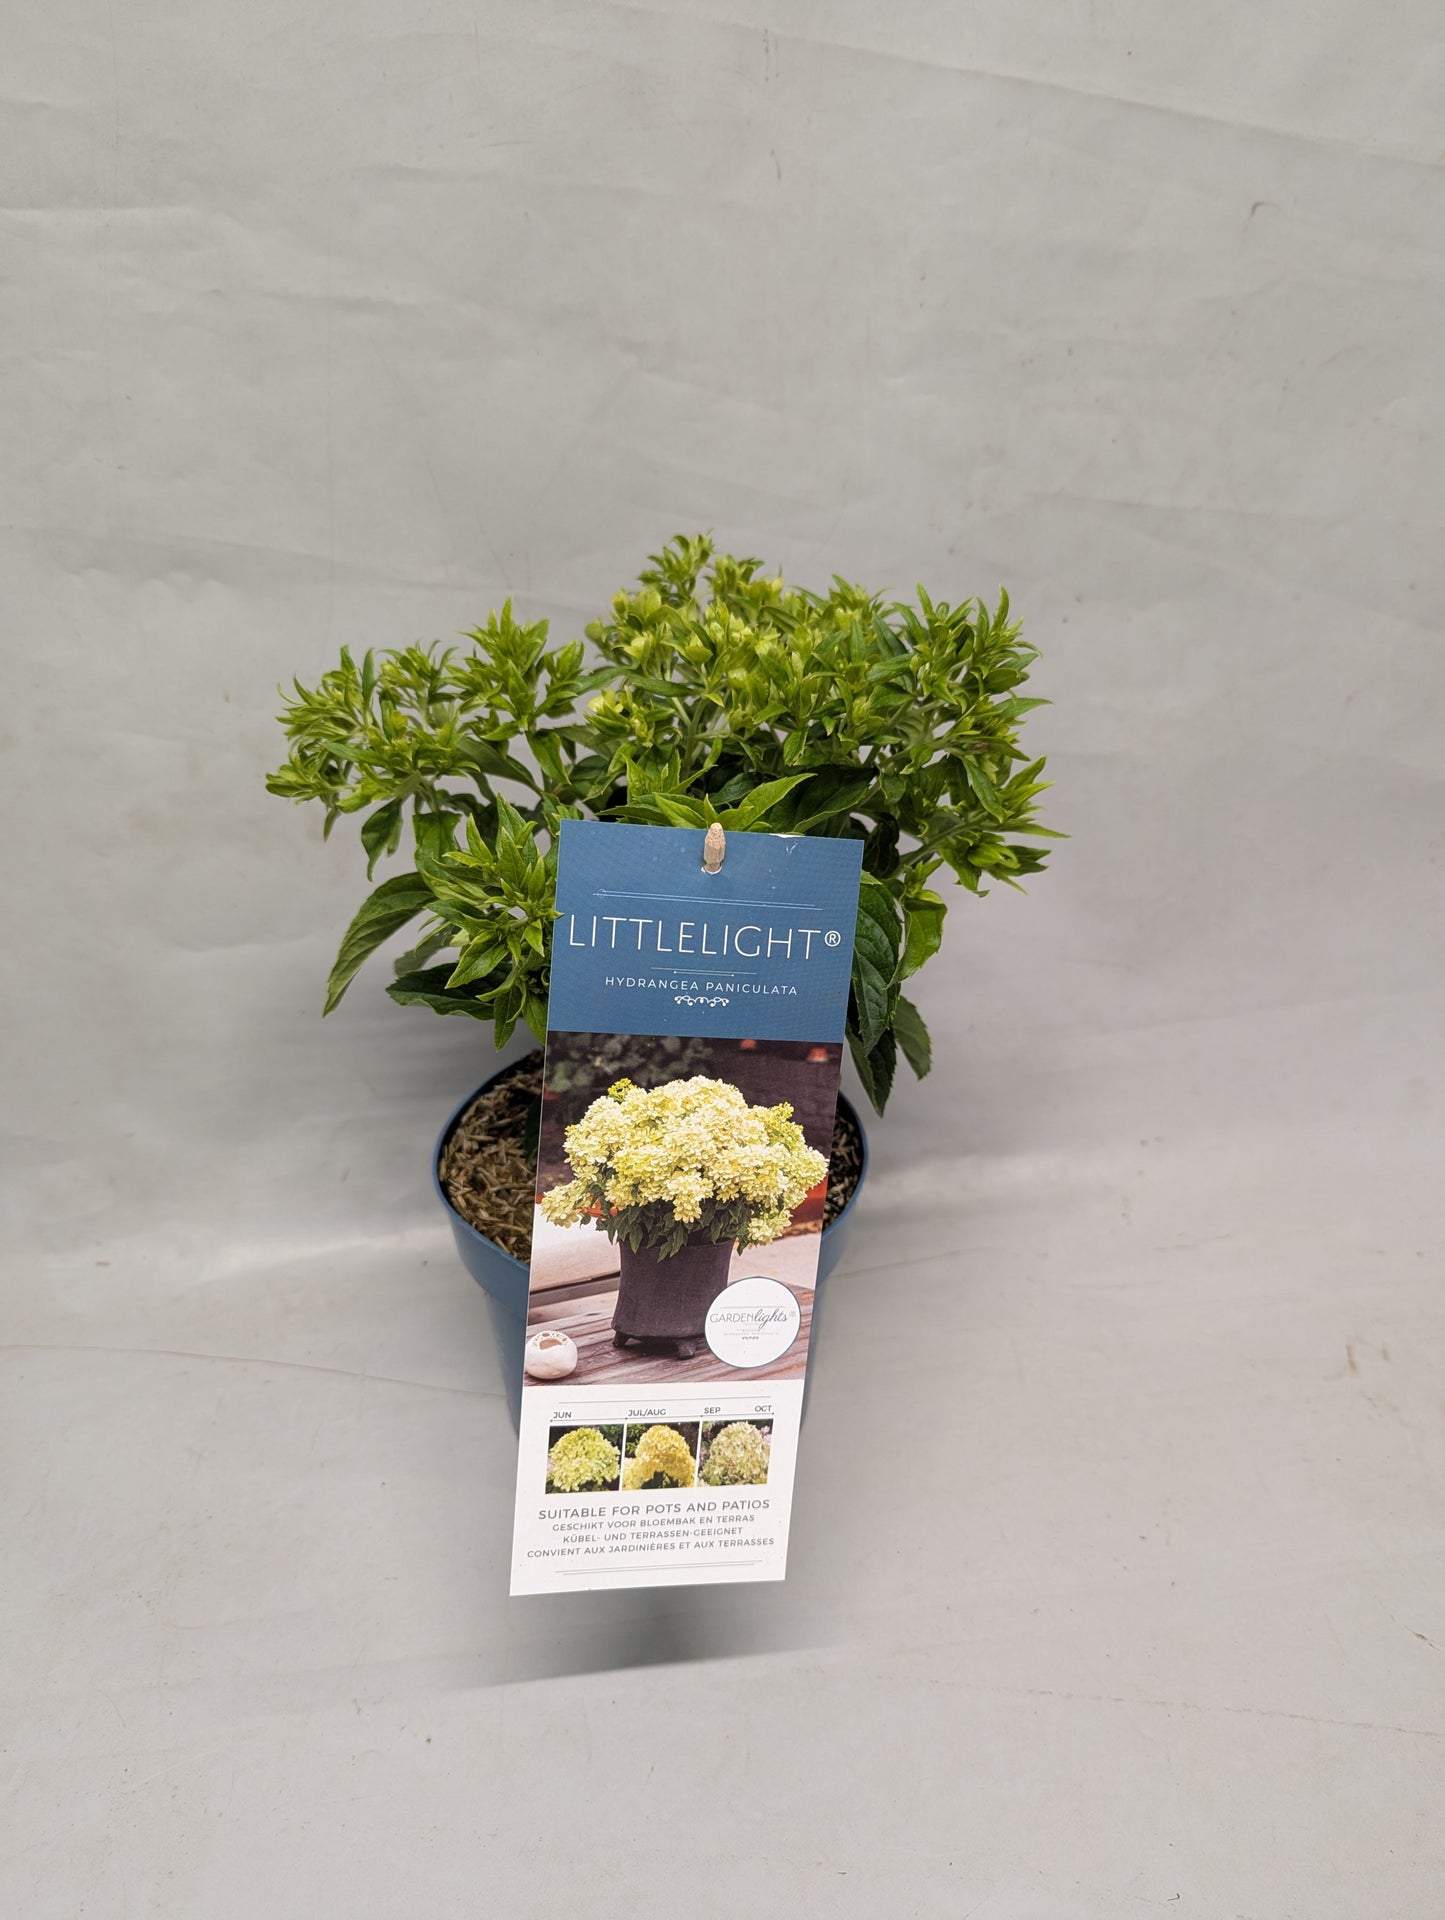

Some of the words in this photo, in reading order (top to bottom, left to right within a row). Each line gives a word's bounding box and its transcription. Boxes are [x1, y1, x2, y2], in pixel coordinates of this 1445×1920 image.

[605, 976, 698, 991] HYDRANGEA
[706, 981, 798, 996] PANICULATA
[553, 1411, 571, 1419] JUN
[628, 1408, 666, 1417] JUL/AUG
[539, 1507, 606, 1520] SUITABLE
[612, 1505, 640, 1516] FOR
[646, 1503, 681, 1514] POTS
[687, 1501, 717, 1513] AND
[722, 1499, 770, 1511] PATIOS
[552, 1521, 604, 1532] GESCHIKT
[608, 1520, 636, 1529] VOOR
[640, 1517, 696, 1527] BLOEMBAK
[699, 1516, 713, 1524] EN
[716, 1514, 755, 1524] TERRAS
[563, 1533, 601, 1543] KÜBEL-
[604, 1532, 627, 1541] UND
[631, 1527, 743, 1540] TERRASSEN-GEEIGNET
[527, 1548, 581, 1558] CONVIENT
[584, 1546, 605, 1555] AUX
[609, 1541, 675, 1553] JARDINIÈRES
[694, 1540, 715, 1549] AUX
[718, 1537, 774, 1548] TERRASSES
